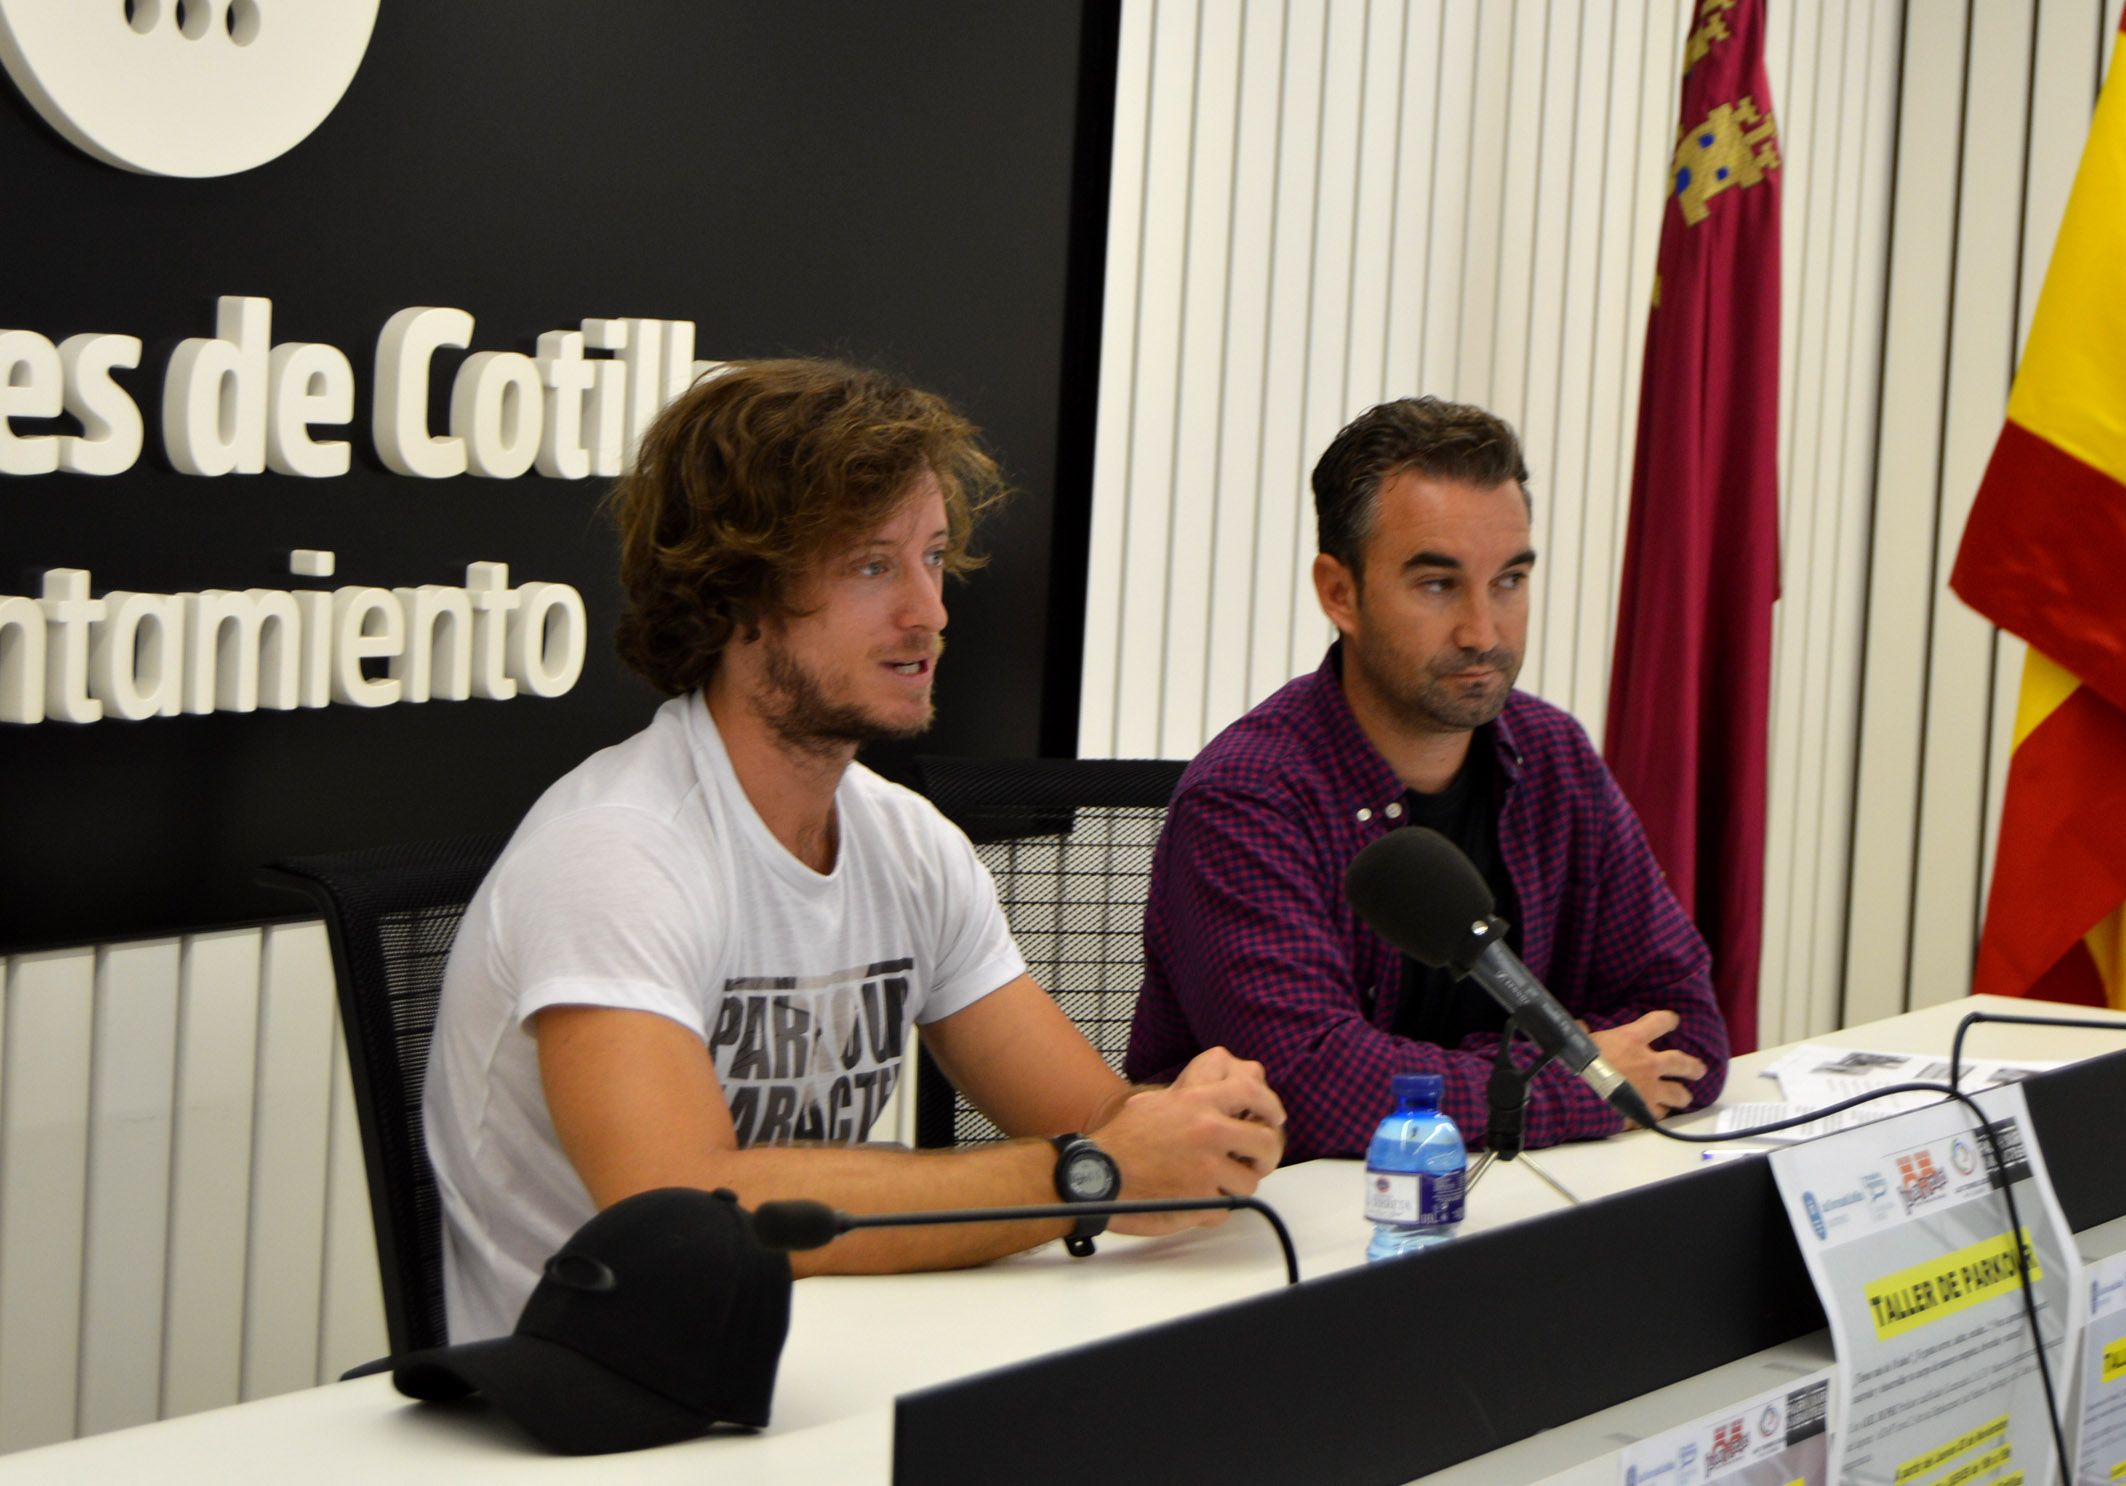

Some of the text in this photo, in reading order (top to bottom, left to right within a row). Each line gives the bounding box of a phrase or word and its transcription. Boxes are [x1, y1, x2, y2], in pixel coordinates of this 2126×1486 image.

[161, 295, 354, 478] de
[373, 306, 733, 480] Cotill
[0, 549, 587, 724] ntamiento
[1869, 1243, 2039, 1328] TALLER DE PARKOR
